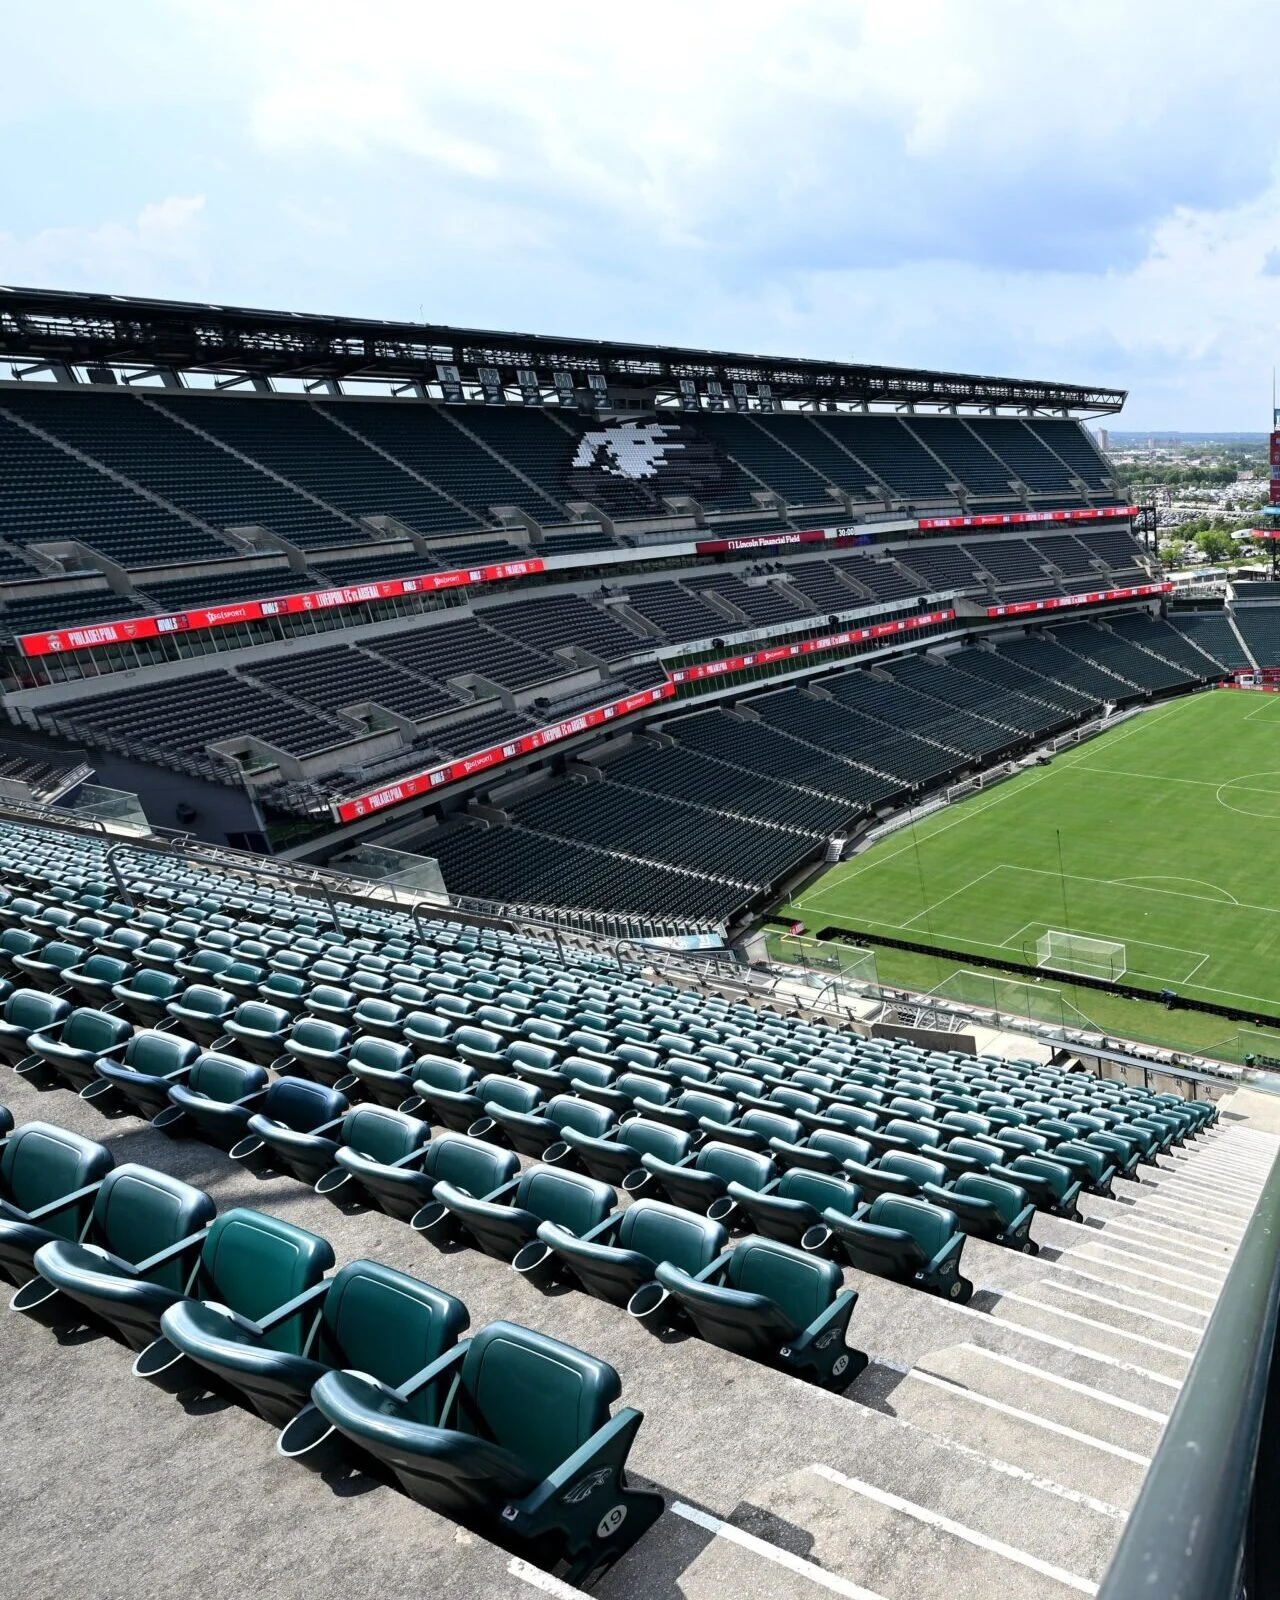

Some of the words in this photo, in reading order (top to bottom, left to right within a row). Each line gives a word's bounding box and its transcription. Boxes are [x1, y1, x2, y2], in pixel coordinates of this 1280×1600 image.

[838, 528, 855, 537] 30:00
[735, 538, 759, 549] Lincoln
[759, 536, 785, 546] Financial
[785, 535, 800, 543] Field
[68, 626, 118, 647] PHILADELPHIA
[368, 786, 404, 809] PHILADELPHIA
[834, 1359, 847, 1372] 18
[601, 1510, 622, 1532] 19
